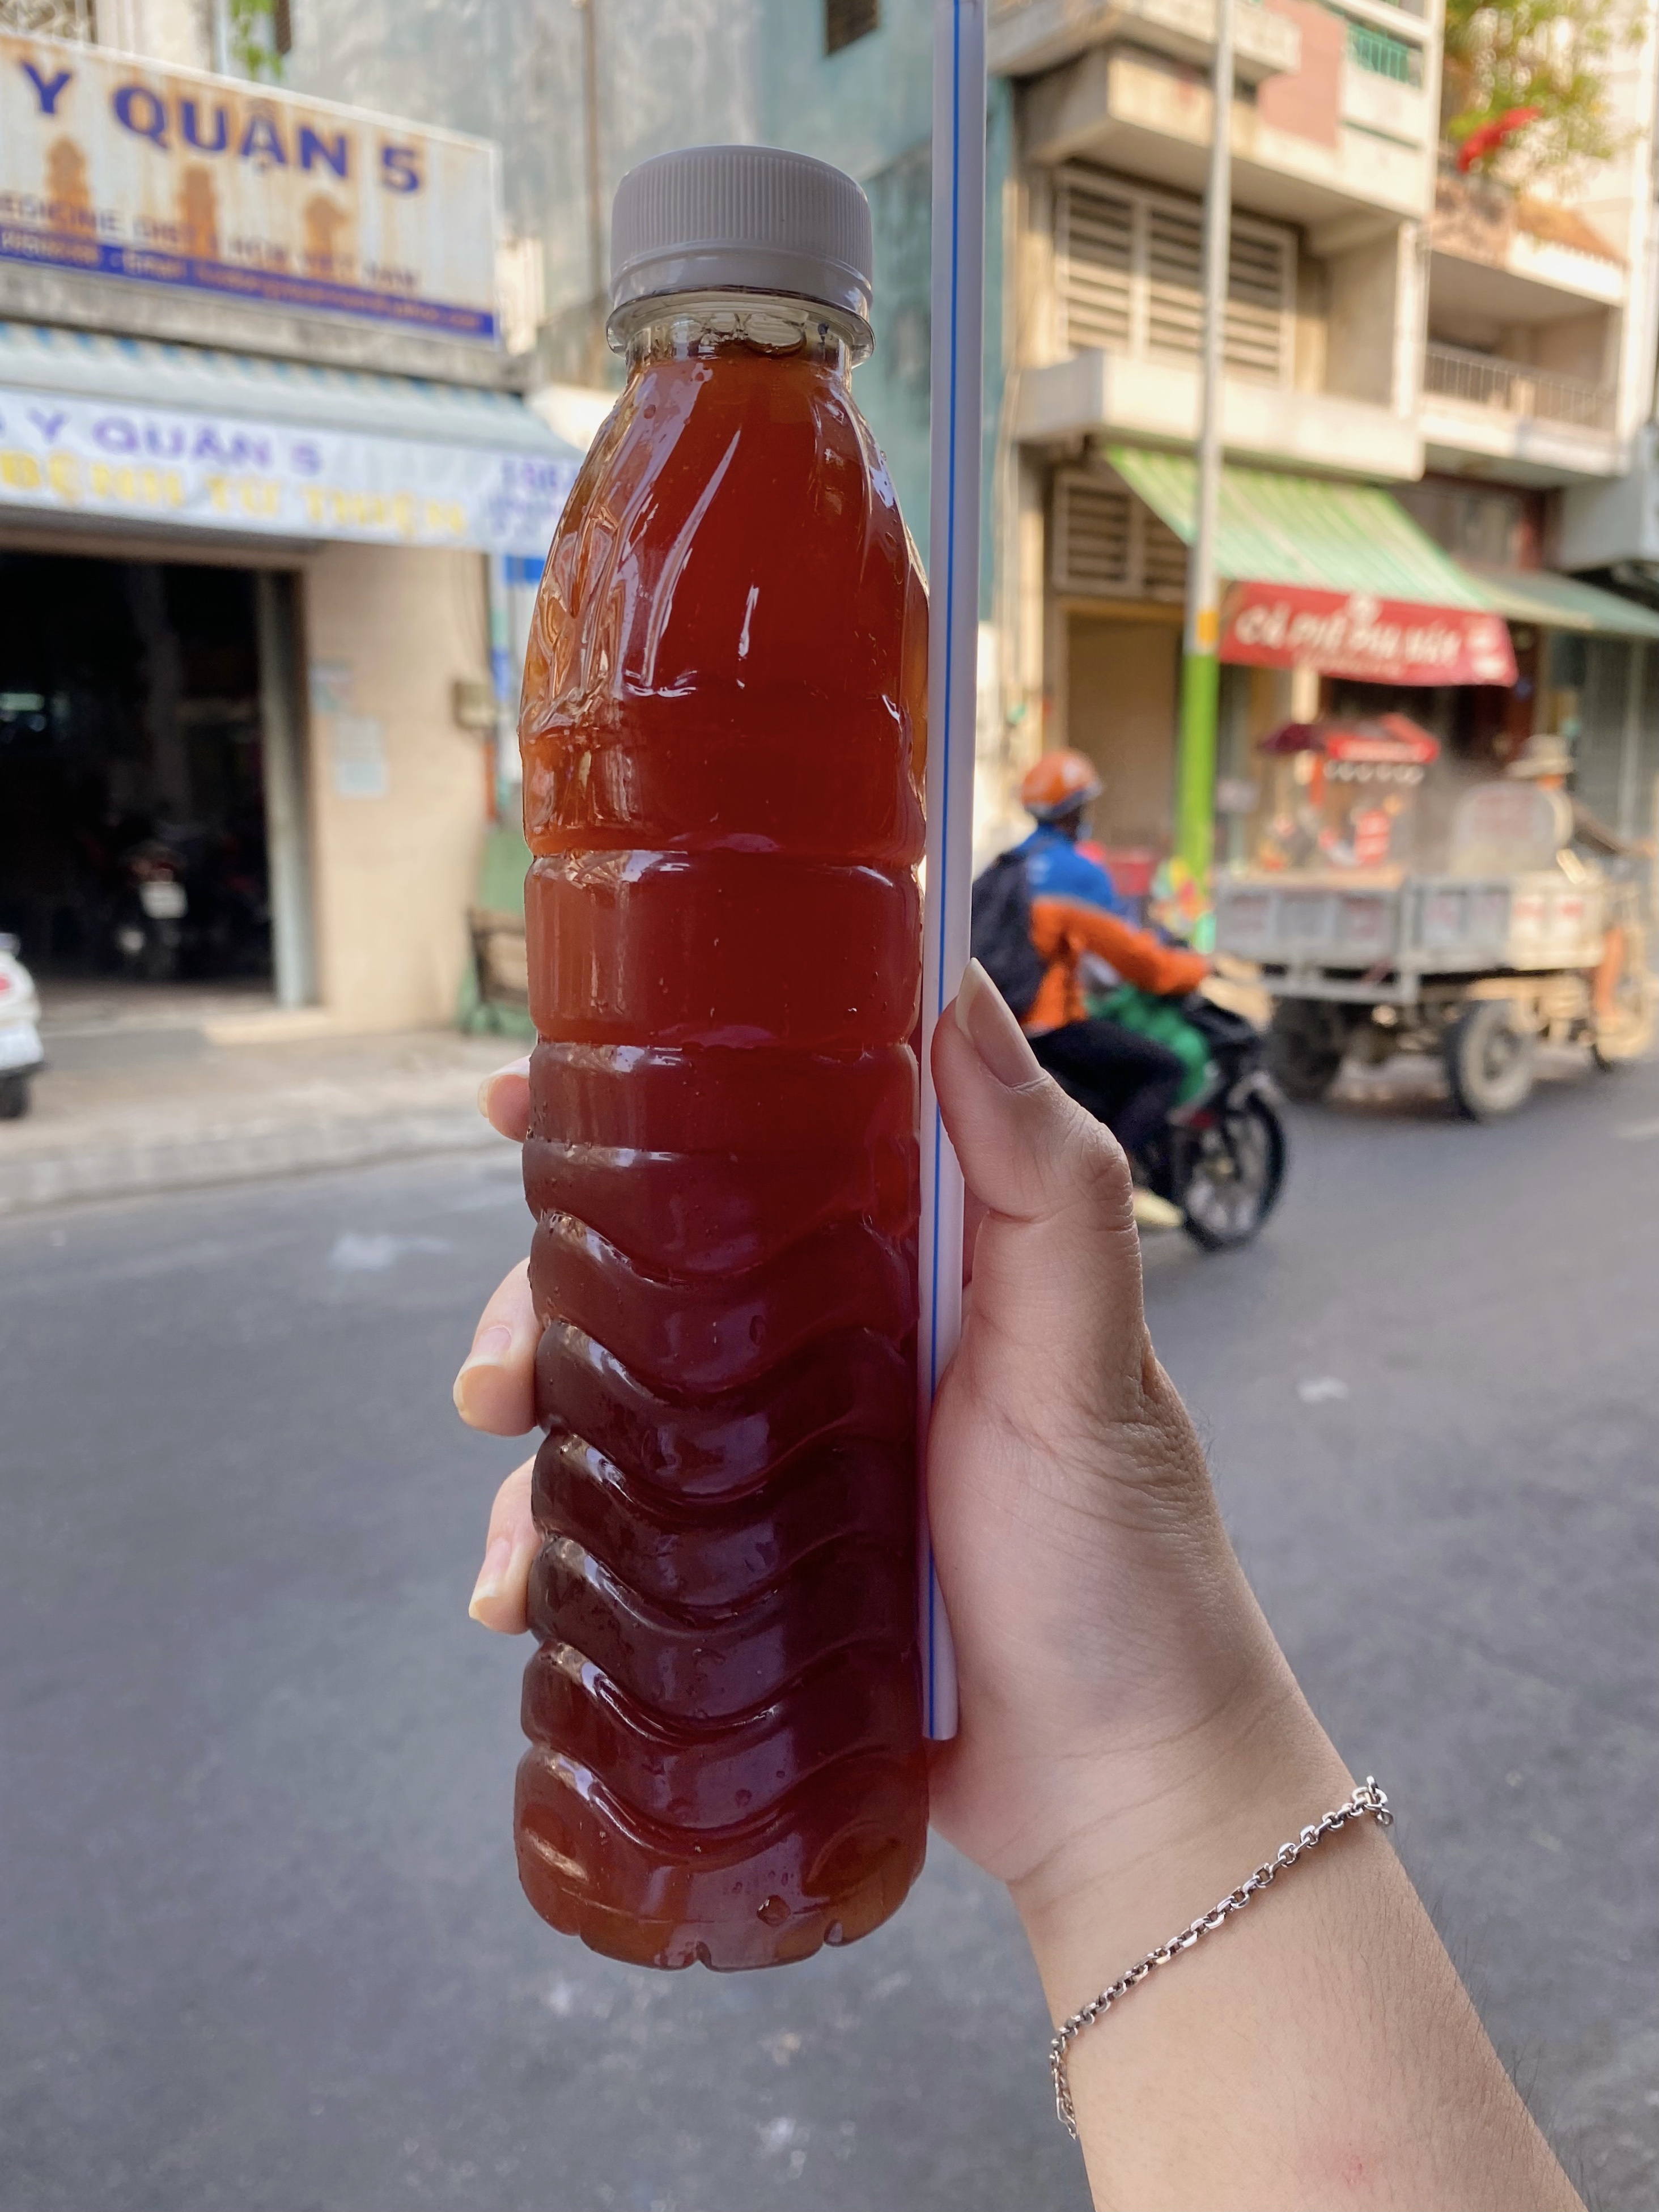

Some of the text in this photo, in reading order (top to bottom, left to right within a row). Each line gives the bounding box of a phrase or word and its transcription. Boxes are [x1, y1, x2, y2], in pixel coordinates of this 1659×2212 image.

[21, 60, 422, 194] Y QUẬN 5
[26, 407, 68, 445] Y
